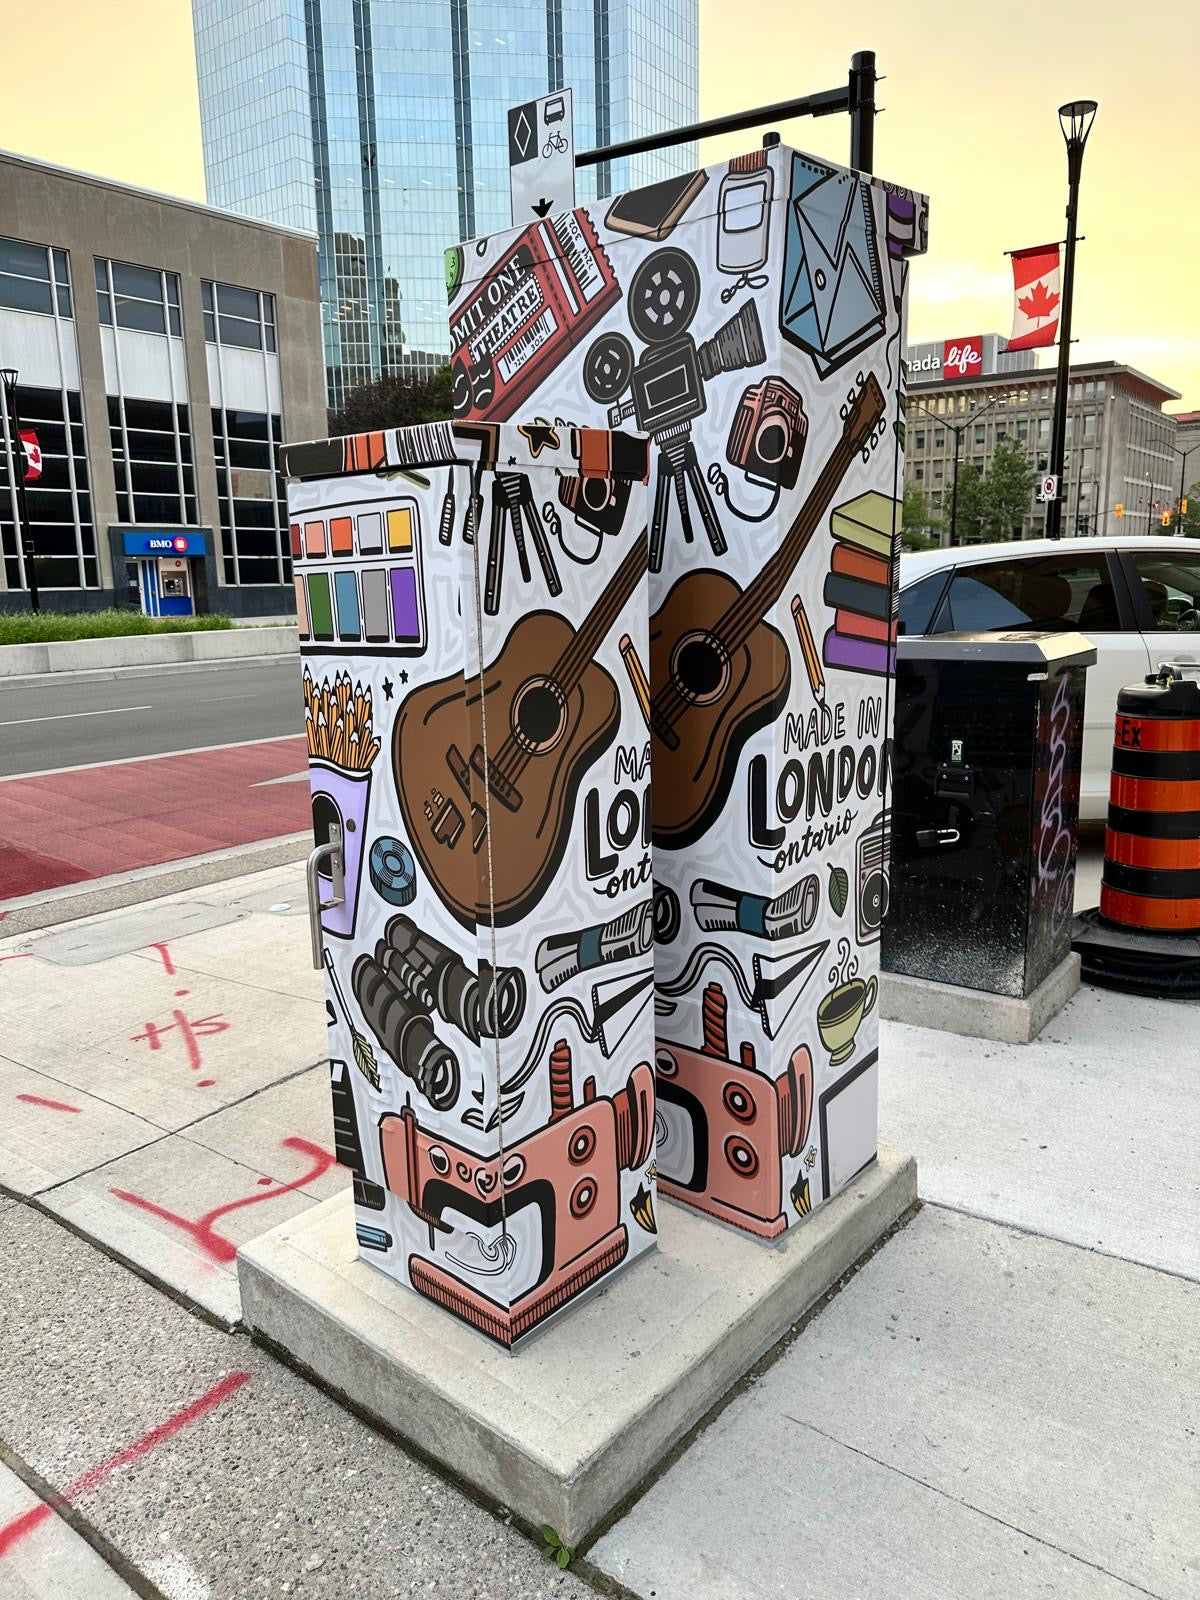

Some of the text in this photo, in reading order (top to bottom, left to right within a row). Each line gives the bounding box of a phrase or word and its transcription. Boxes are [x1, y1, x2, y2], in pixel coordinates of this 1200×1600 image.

[568, 218, 582, 241] 302
[487, 254, 526, 305] ONE
[473, 285, 538, 356] THEATRE
[530, 335, 545, 352] 302
[943, 344, 982, 374] life
[149, 539, 173, 549] BMO
[783, 696, 882, 754] MADE IN
[757, 808, 859, 873] ontario
[593, 852, 652, 898] ont
